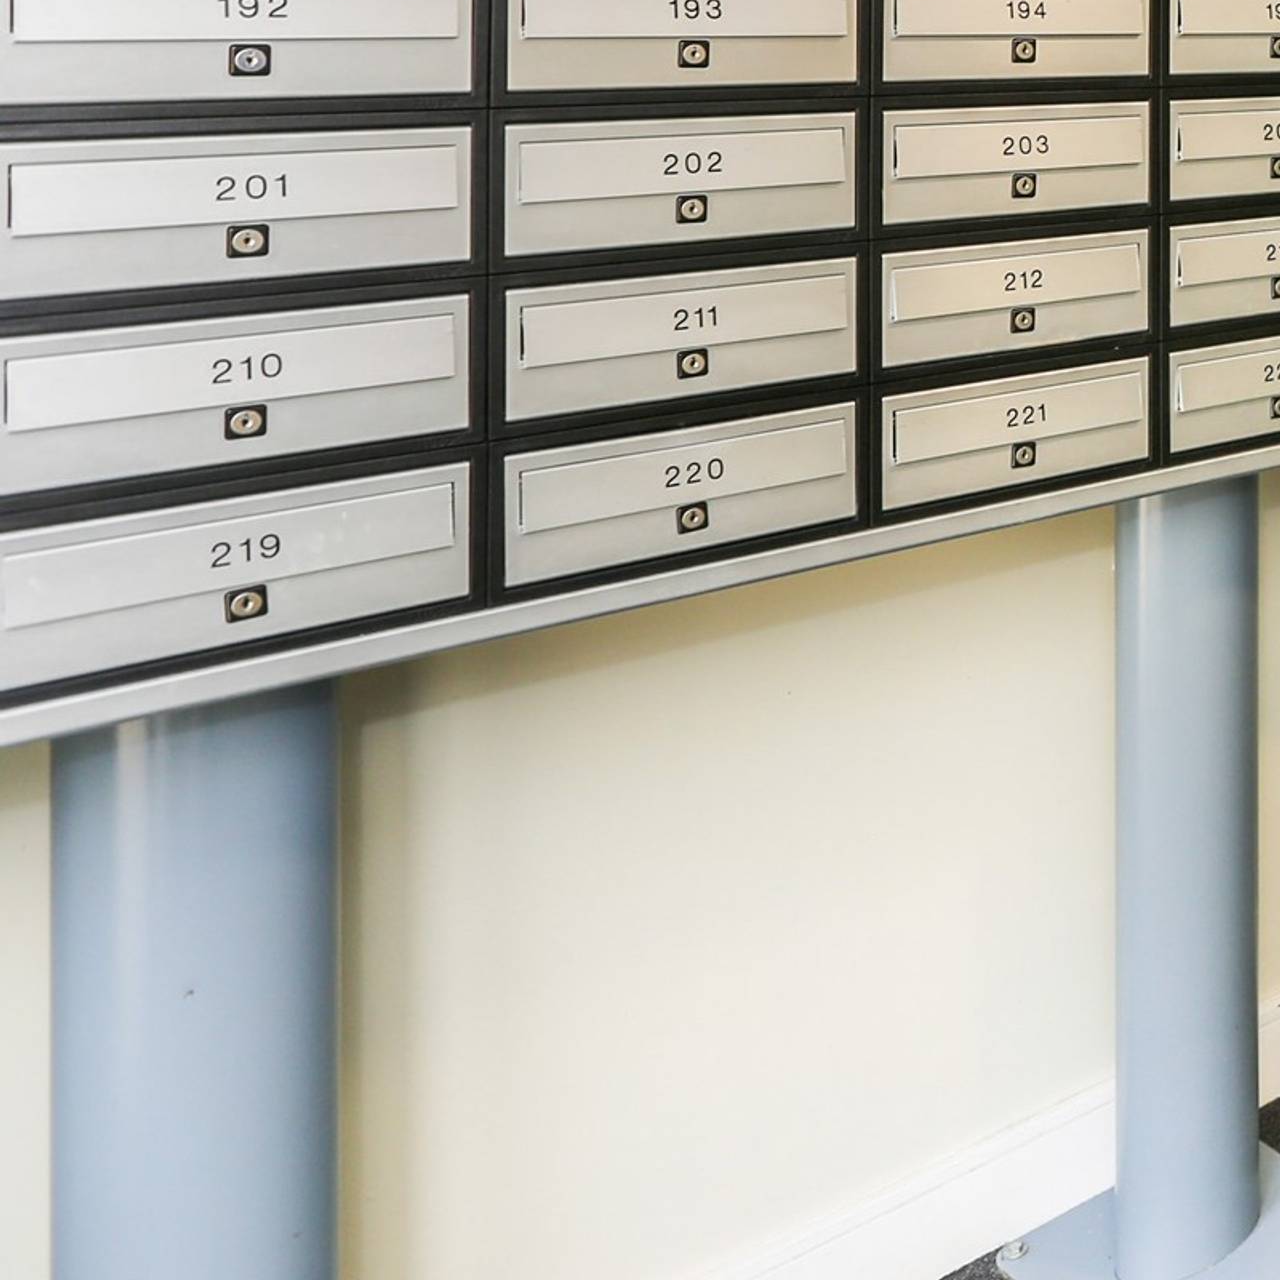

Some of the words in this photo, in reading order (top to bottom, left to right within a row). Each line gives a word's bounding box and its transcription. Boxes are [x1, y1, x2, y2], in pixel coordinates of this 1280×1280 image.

[1006, 0, 1047, 20] 194
[1002, 134, 1049, 156] 203
[663, 151, 723, 176] 202
[215, 173, 287, 202] 201
[1004, 269, 1043, 292] 212
[673, 305, 717, 331] 211
[212, 353, 283, 385] 210
[1006, 403, 1046, 428] 221
[665, 457, 724, 489] 220
[211, 533, 281, 569] 219
